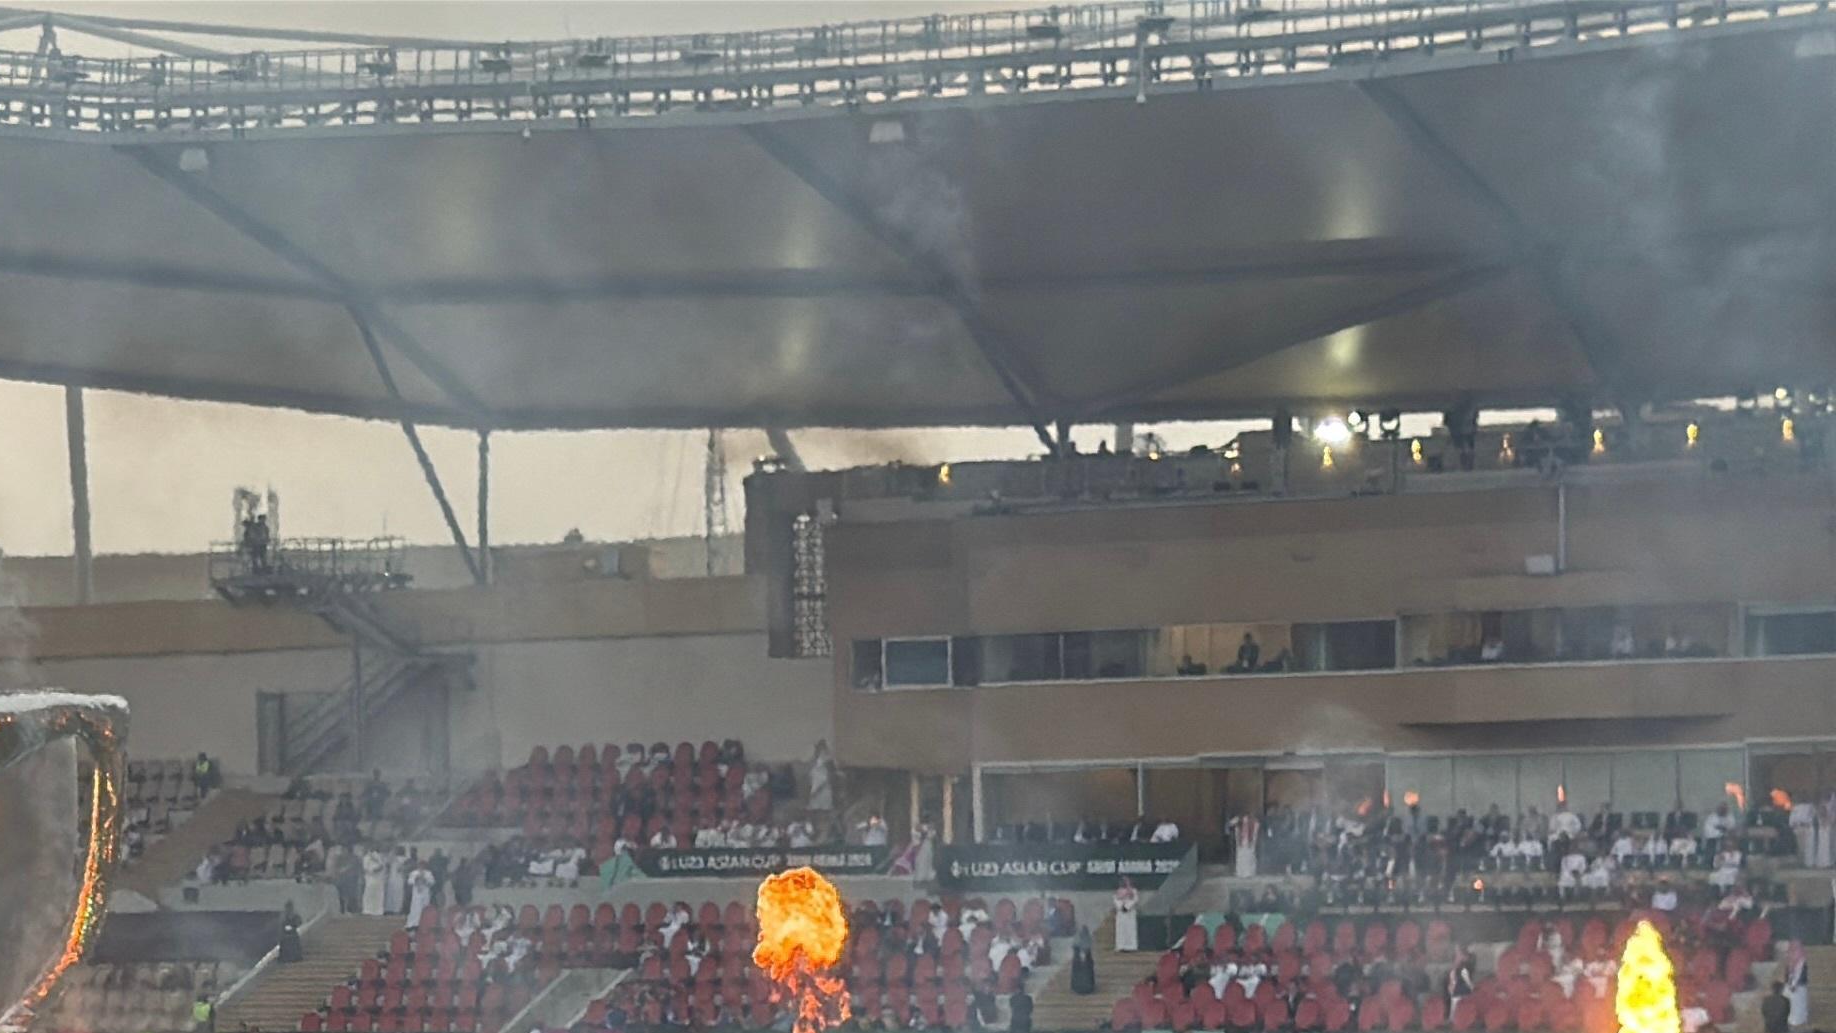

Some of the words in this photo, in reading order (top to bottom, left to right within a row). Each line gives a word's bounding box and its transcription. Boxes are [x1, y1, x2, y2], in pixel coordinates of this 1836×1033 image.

[707, 855, 751, 870] ASIAN
[971, 862, 998, 876] U23
[1000, 861, 1048, 876] ASIAN
[1050, 861, 1081, 875] CUP
